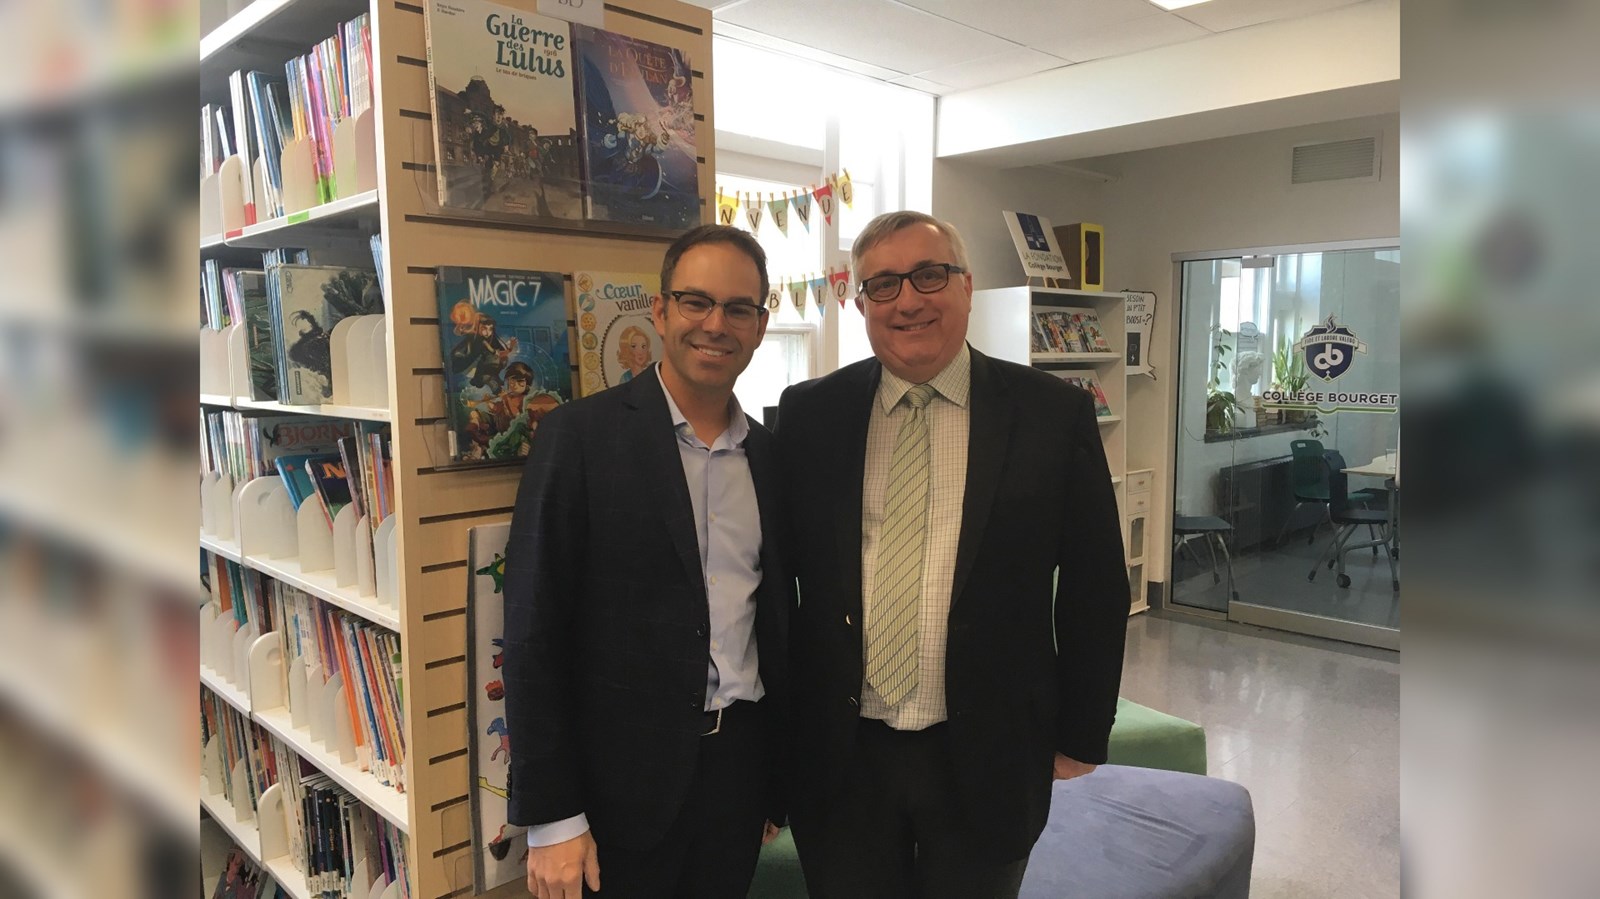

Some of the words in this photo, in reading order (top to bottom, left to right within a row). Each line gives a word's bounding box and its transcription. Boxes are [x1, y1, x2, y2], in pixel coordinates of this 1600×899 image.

[486, 13, 565, 50] Guerre
[511, 14, 523, 26] La
[506, 39, 524, 51] des
[496, 40, 565, 78] Lulus
[720, 183, 850, 229] NVENUE
[467, 274, 527, 309] MAGIC
[529, 281, 542, 306] 7
[596, 283, 642, 300] Cœur
[1328, 393, 1398, 405] BOURGET
